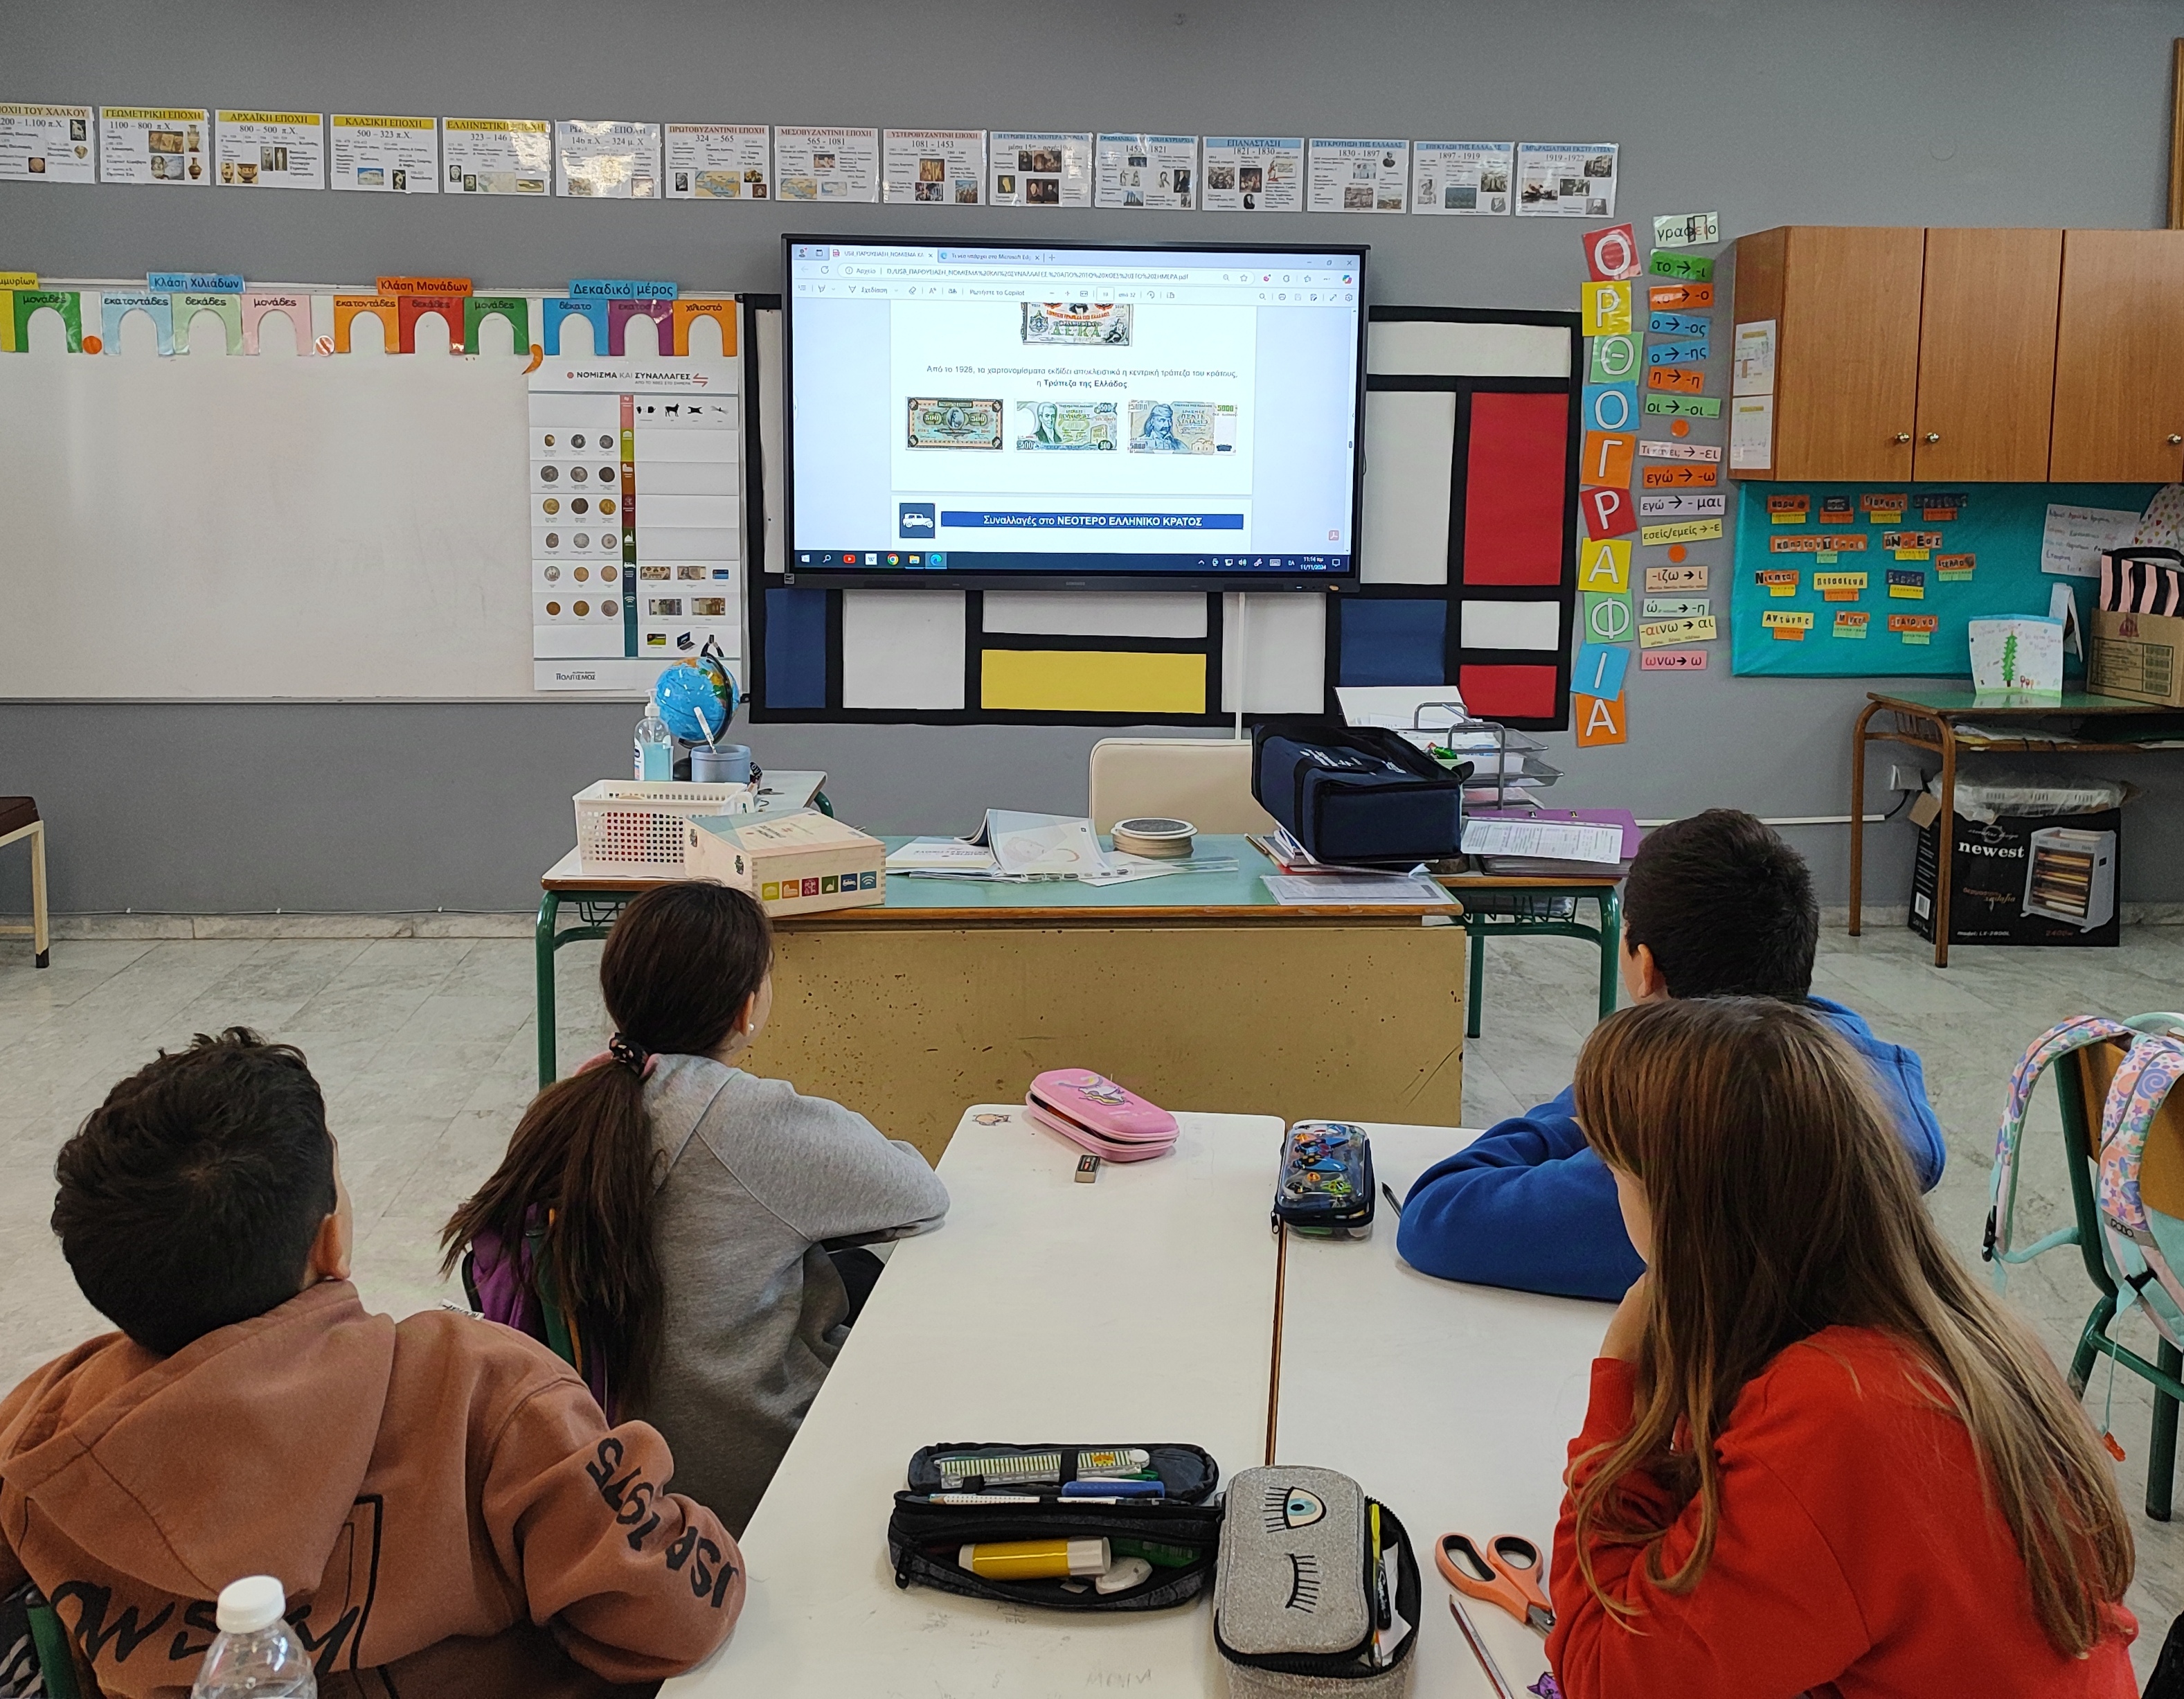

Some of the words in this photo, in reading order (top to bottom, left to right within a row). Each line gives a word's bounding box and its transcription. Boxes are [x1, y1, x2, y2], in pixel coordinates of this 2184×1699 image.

[24, 107, 43, 116] ΤΟΥ
[46, 108, 87, 116] ΧΑΛΚΟΥ
[106, 109, 166, 118] ΓΕΩΜΕΤΡΙΚΗ
[168, 111, 201, 119] ΕΠΟΧΗ
[25, 118, 46, 127] 1.100
[231, 112, 272, 122] ΑΡΧΑΪΚΗ
[275, 114, 307, 123] ΕΠΟΧΗ
[346, 117, 387, 127] ΚΛΑΣΙΚΗ
[389, 118, 422, 128] ΕΠΟΧΗ
[110, 121, 129, 130] 1100
[447, 121, 509, 130] ΕΛΛΗΝΙΣΤΙΚΗ
[357, 130, 370, 138] 500
[380, 130, 395, 139] 323
[1227, 139, 1280, 148] ΕΠΑΝΑΣΤΑΣΗ
[1656, 261, 1671, 272] το
[154, 278, 187, 290] Κλάση
[190, 278, 239, 289] Χιλιάδων
[381, 281, 414, 292] Κλάση
[417, 281, 468, 292] Μονάδων
[573, 283, 631, 296] Δεκαδικό
[636, 285, 673, 298] μέρος
[23, 294, 66, 305] μονάδες
[105, 297, 168, 307] εκατοντάδες
[186, 296, 226, 307] δεκάδες
[254, 296, 297, 308] μονάδες
[336, 299, 395, 309] εκατοντάδες
[412, 299, 450, 309] δεκάδες
[474, 301, 514, 311] μονάδες
[560, 301, 592, 311] δέκατο
[686, 302, 722, 313] χιλιοστό
[1652, 320, 1661, 330] ο
[1052, 326, 1101, 337] ΔΕΚΑ
[1652, 353, 1661, 363] ο
[635, 372, 690, 380] ΣΥΝΑΛΛΑΓΕΣ
[987, 367, 1046, 375] χαρτονομίσματα
[1161, 369, 1190, 377] τράπεζα
[1654, 371, 1661, 384] η
[1044, 380, 1076, 388] Τράπεζα
[1647, 402, 1661, 413] οι
[1641, 445, 1650, 454] Τι
[1647, 470, 1673, 486] εγώ
[1643, 499, 1664, 512] εγώ
[983, 515, 1037, 527] Συναλλαγές
[1057, 515, 1107, 526] ΝΕΟΤΕΡΟ
[1109, 516, 1161, 526] ΕΛΛΗΝΙΚΟ
[1163, 516, 1203, 526] ΚΡΑΤΟΣ
[1698, 619, 1714, 628] αι
[1645, 656, 1675, 666] ωνω
[1691, 656, 1702, 666] ω
[1958, 842, 2025, 858] newest
[2111, 1218, 2133, 1238] POLO
[585, 1437, 661, 1552] 1975
